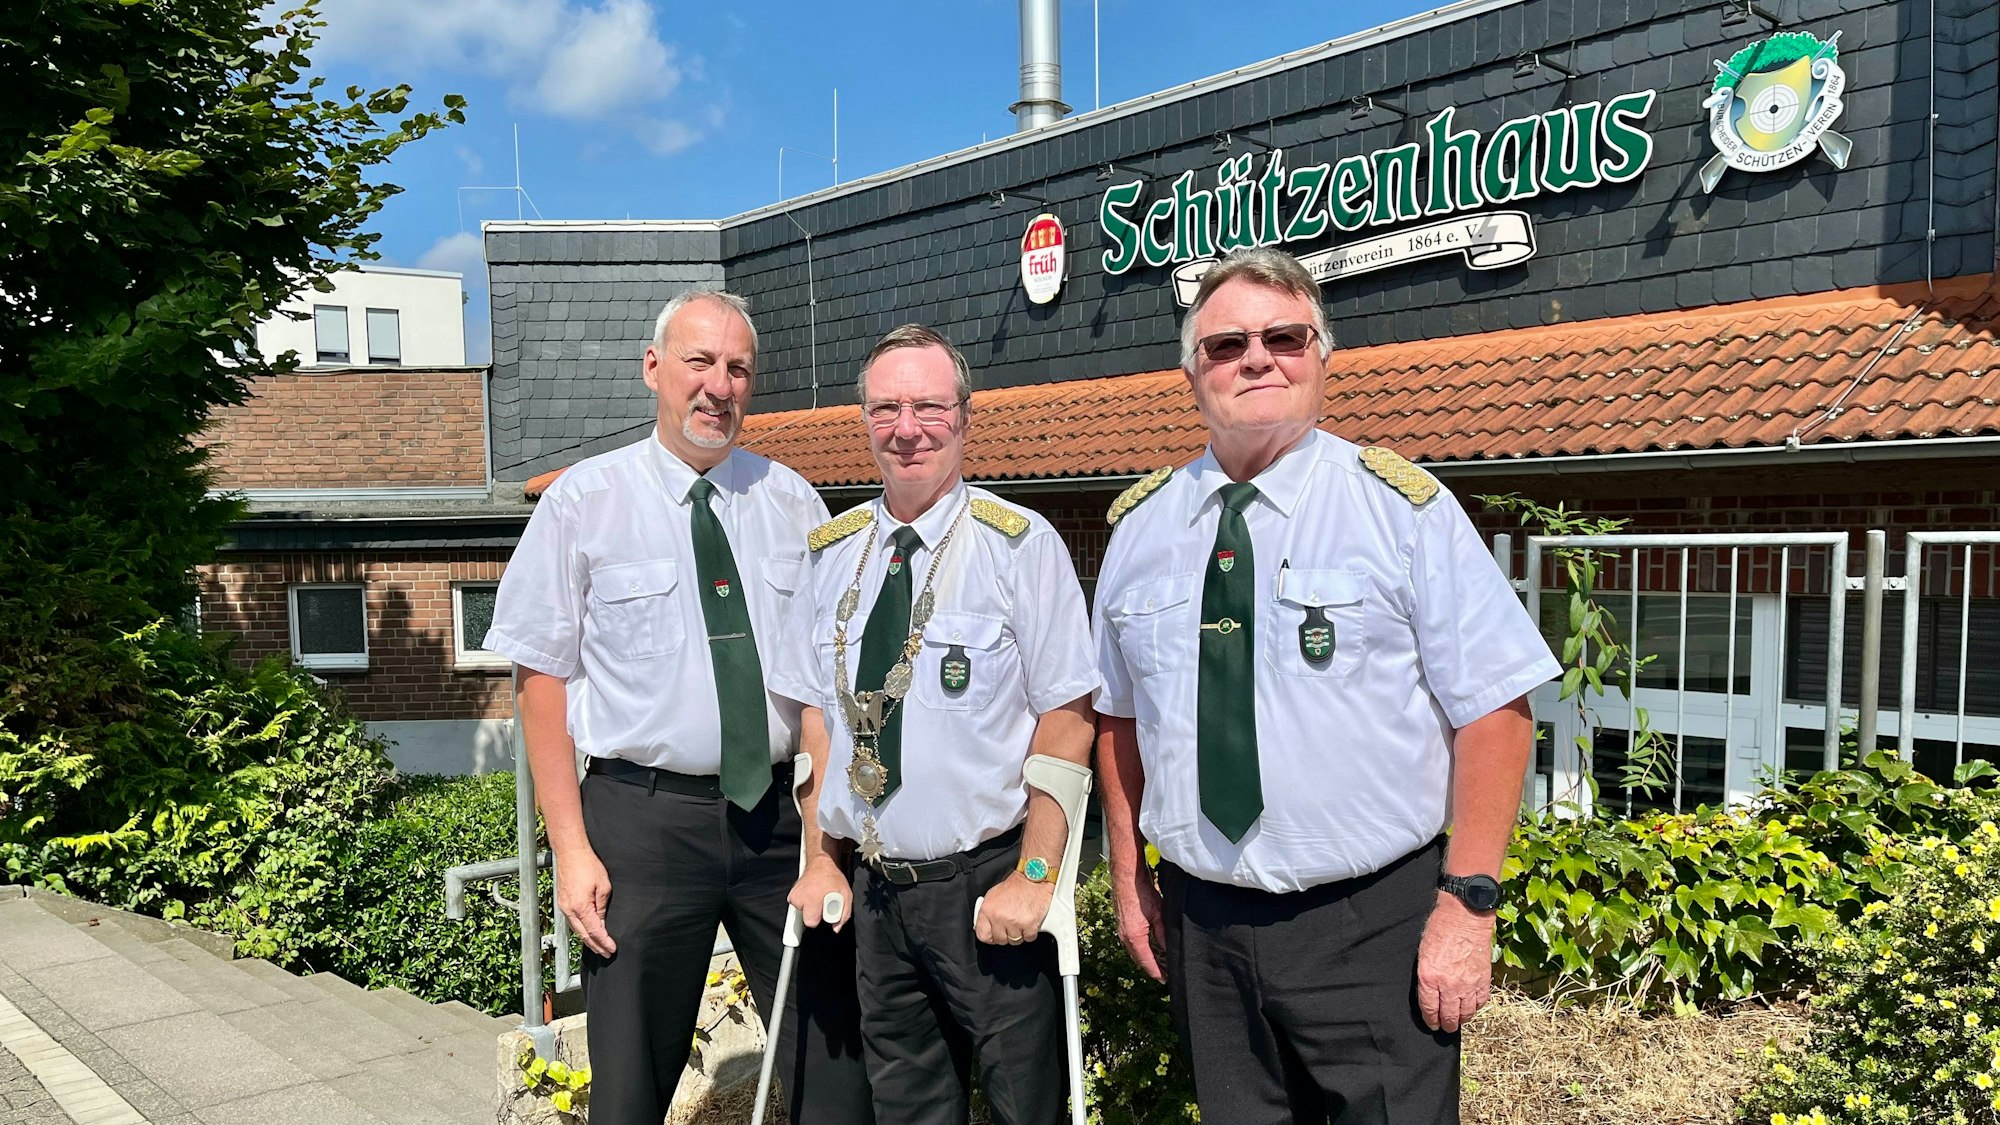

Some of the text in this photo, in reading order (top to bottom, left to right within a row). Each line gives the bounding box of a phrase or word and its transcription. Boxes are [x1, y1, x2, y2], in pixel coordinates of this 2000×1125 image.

[1807, 103, 1837, 136] VEREIN
[1828, 75, 1841, 95] 1864
[1100, 89, 1656, 275] Schützenhaus
[1029, 251, 1057, 276] früh
[1309, 223, 1483, 276] ützenverein 1864 e. V.
